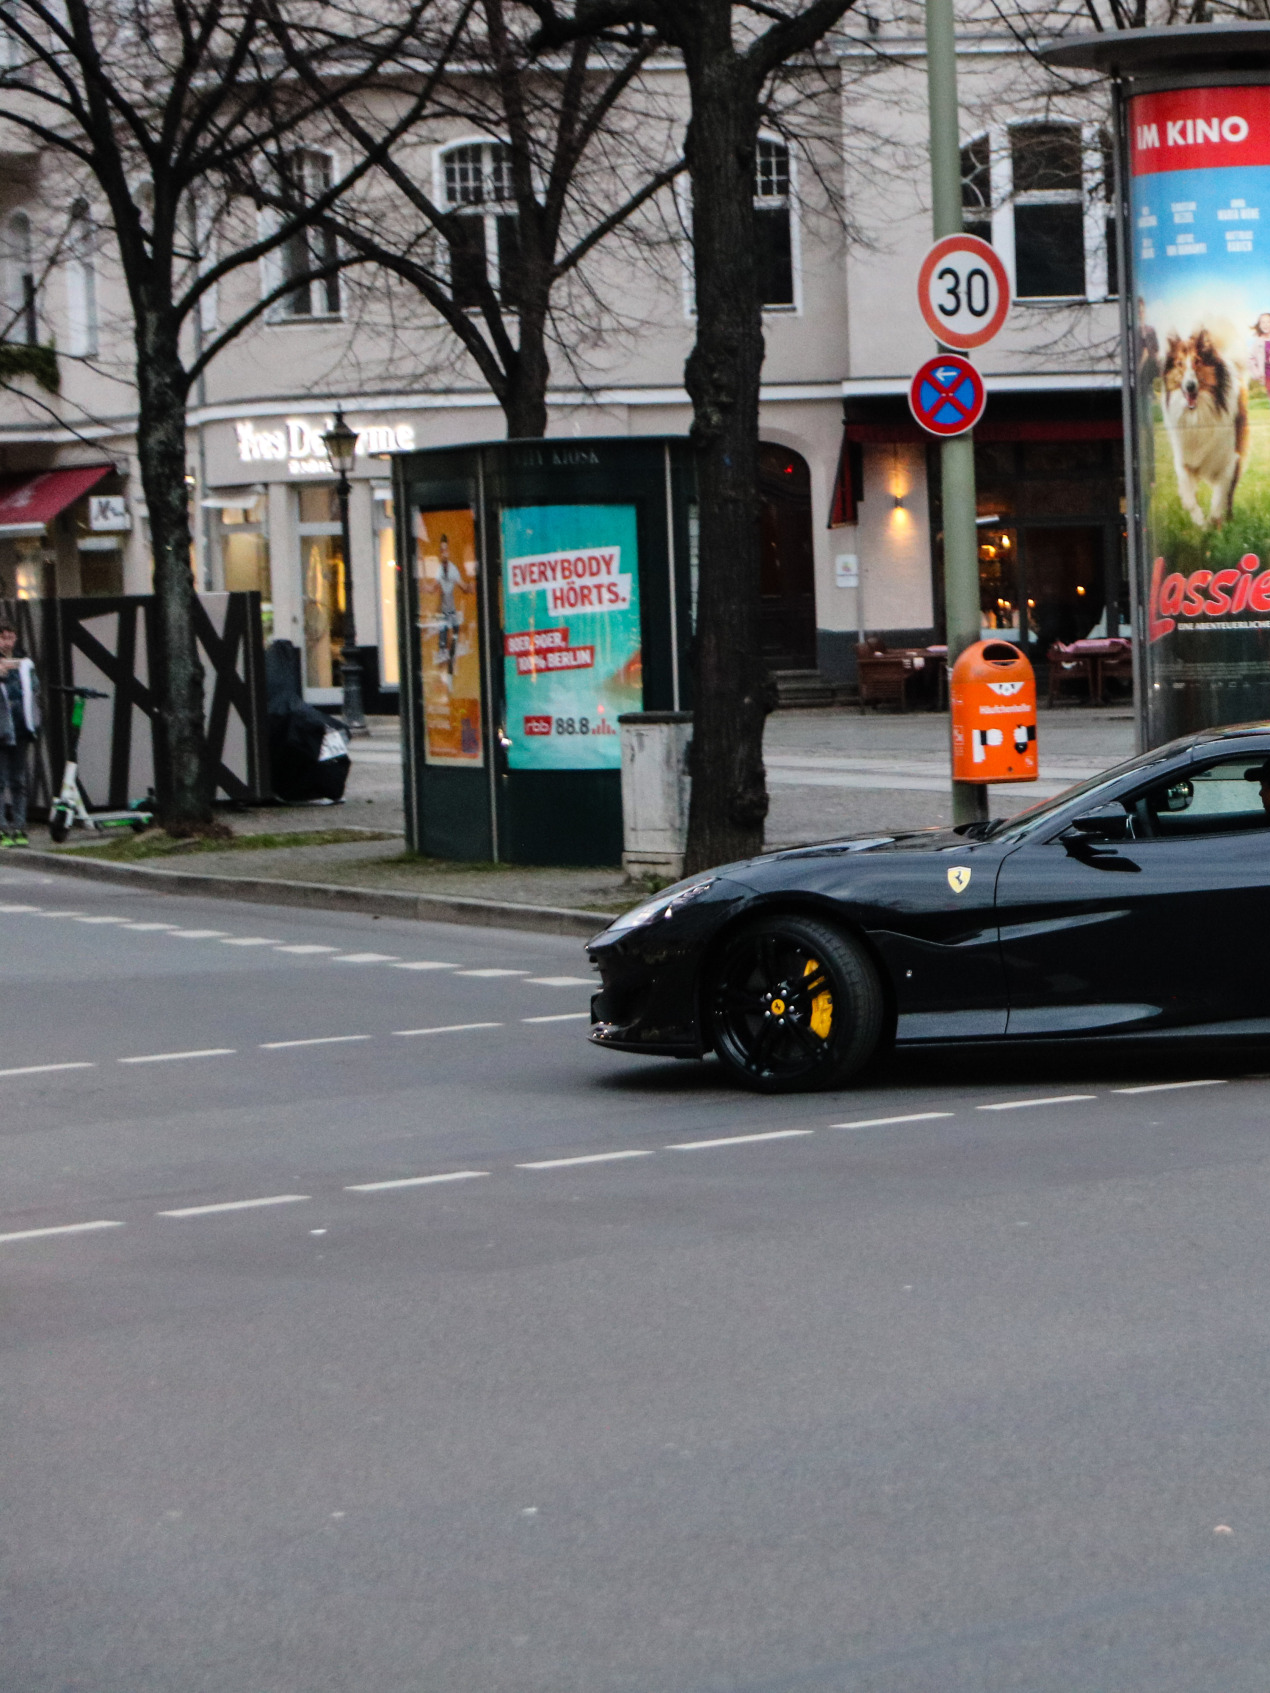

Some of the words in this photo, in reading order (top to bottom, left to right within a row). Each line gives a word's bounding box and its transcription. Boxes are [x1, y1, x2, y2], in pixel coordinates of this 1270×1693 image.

[1136, 122, 1160, 150] IM
[1166, 115, 1249, 147] KINO
[937, 267, 990, 318] 30
[512, 554, 615, 588] EVERYBODY
[552, 580, 627, 610] HÖRTS.
[1177, 622, 1195, 631] EINE
[547, 649, 593, 668] BERLIN
[525, 719, 550, 733] rbb
[555, 717, 590, 735] 88.8
